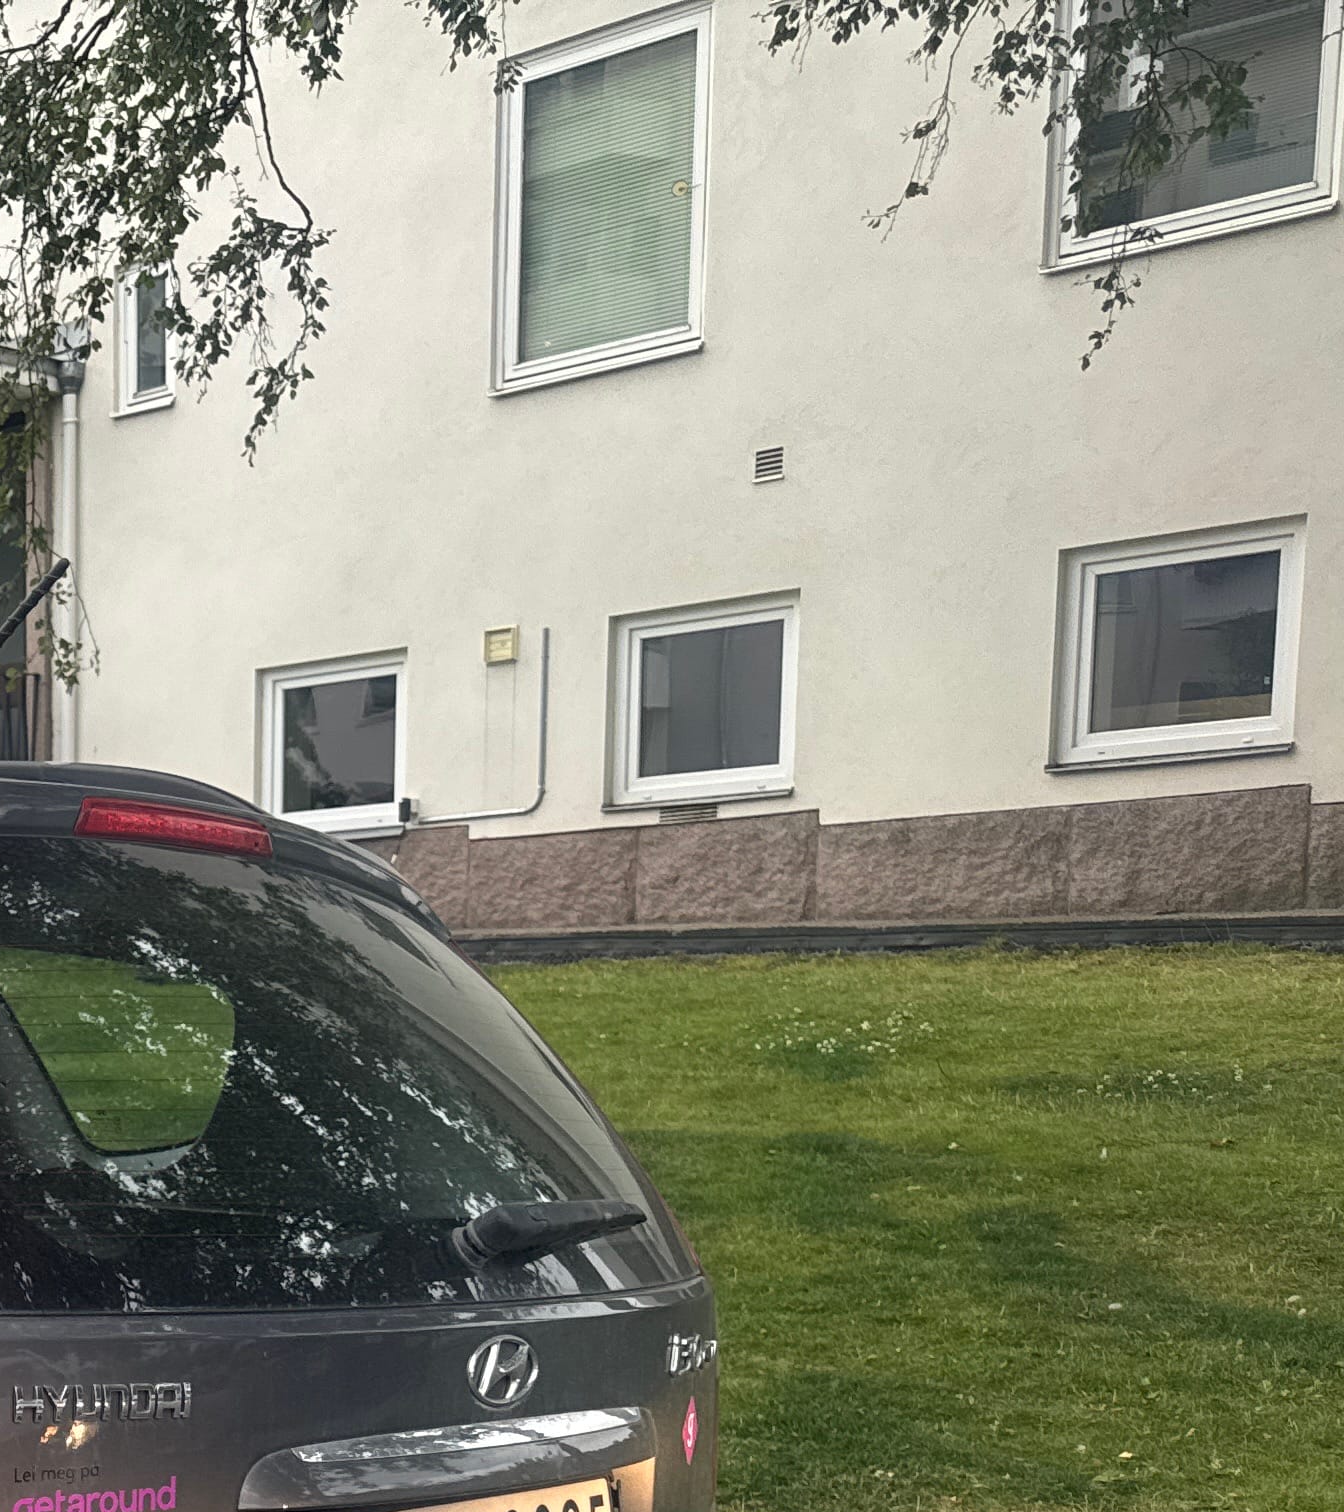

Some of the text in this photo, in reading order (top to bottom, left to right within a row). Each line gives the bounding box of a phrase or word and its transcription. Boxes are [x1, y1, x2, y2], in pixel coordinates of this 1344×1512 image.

[13, 1382, 192, 1423] HYUNDAI
[14, 1466, 35, 1483] Lei
[41, 1467, 75, 1484] meg
